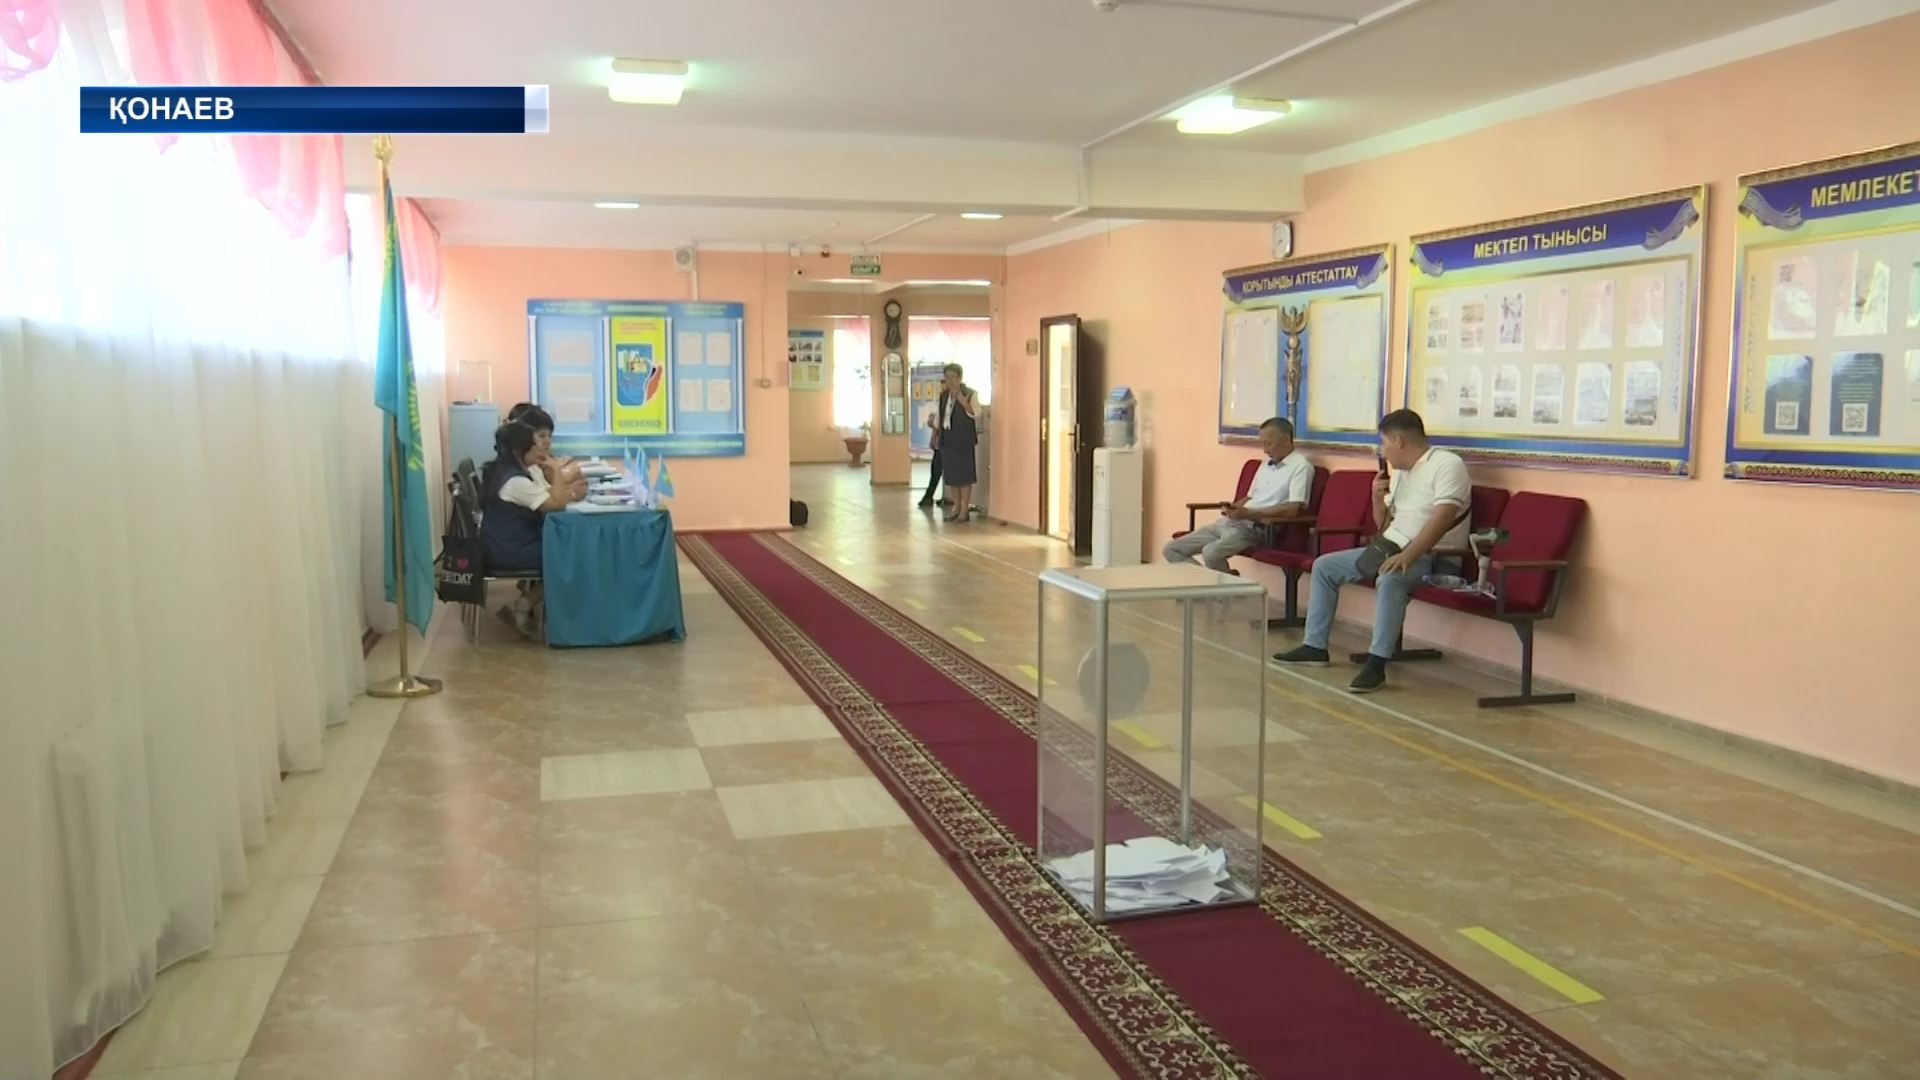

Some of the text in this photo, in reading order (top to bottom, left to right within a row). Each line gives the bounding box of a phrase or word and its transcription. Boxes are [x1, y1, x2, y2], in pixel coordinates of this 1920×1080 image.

[1473, 223, 1608, 259] МЕКТЕП ТЫНЫСЫ
[1295, 265, 1360, 286] АТТЕСТАТТАУ
